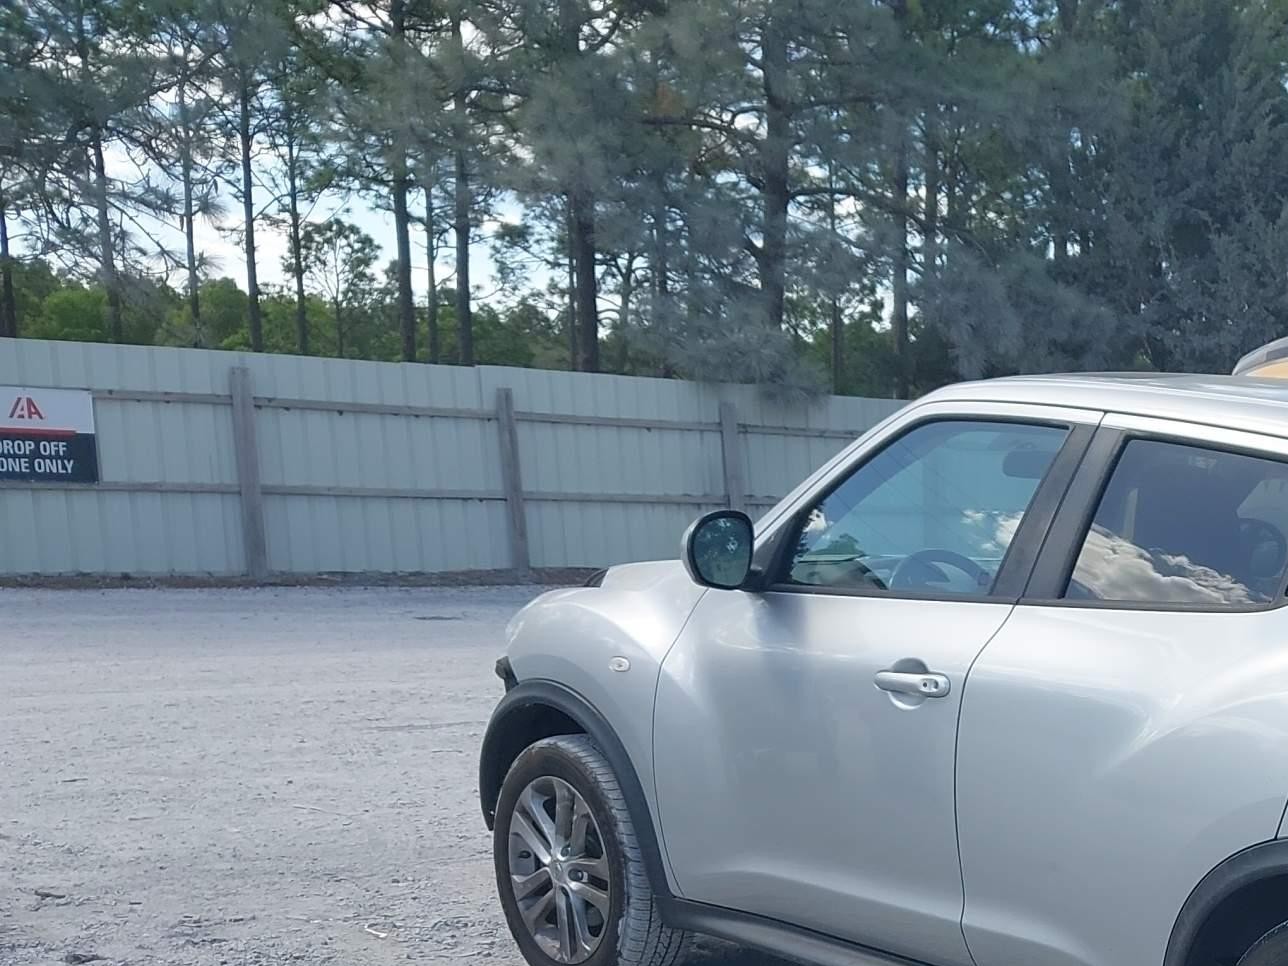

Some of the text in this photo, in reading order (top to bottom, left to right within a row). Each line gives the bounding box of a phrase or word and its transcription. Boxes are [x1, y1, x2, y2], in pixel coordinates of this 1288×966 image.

[0, 439, 68, 456] ROP OFF
[33, 459, 74, 474] ONLY
